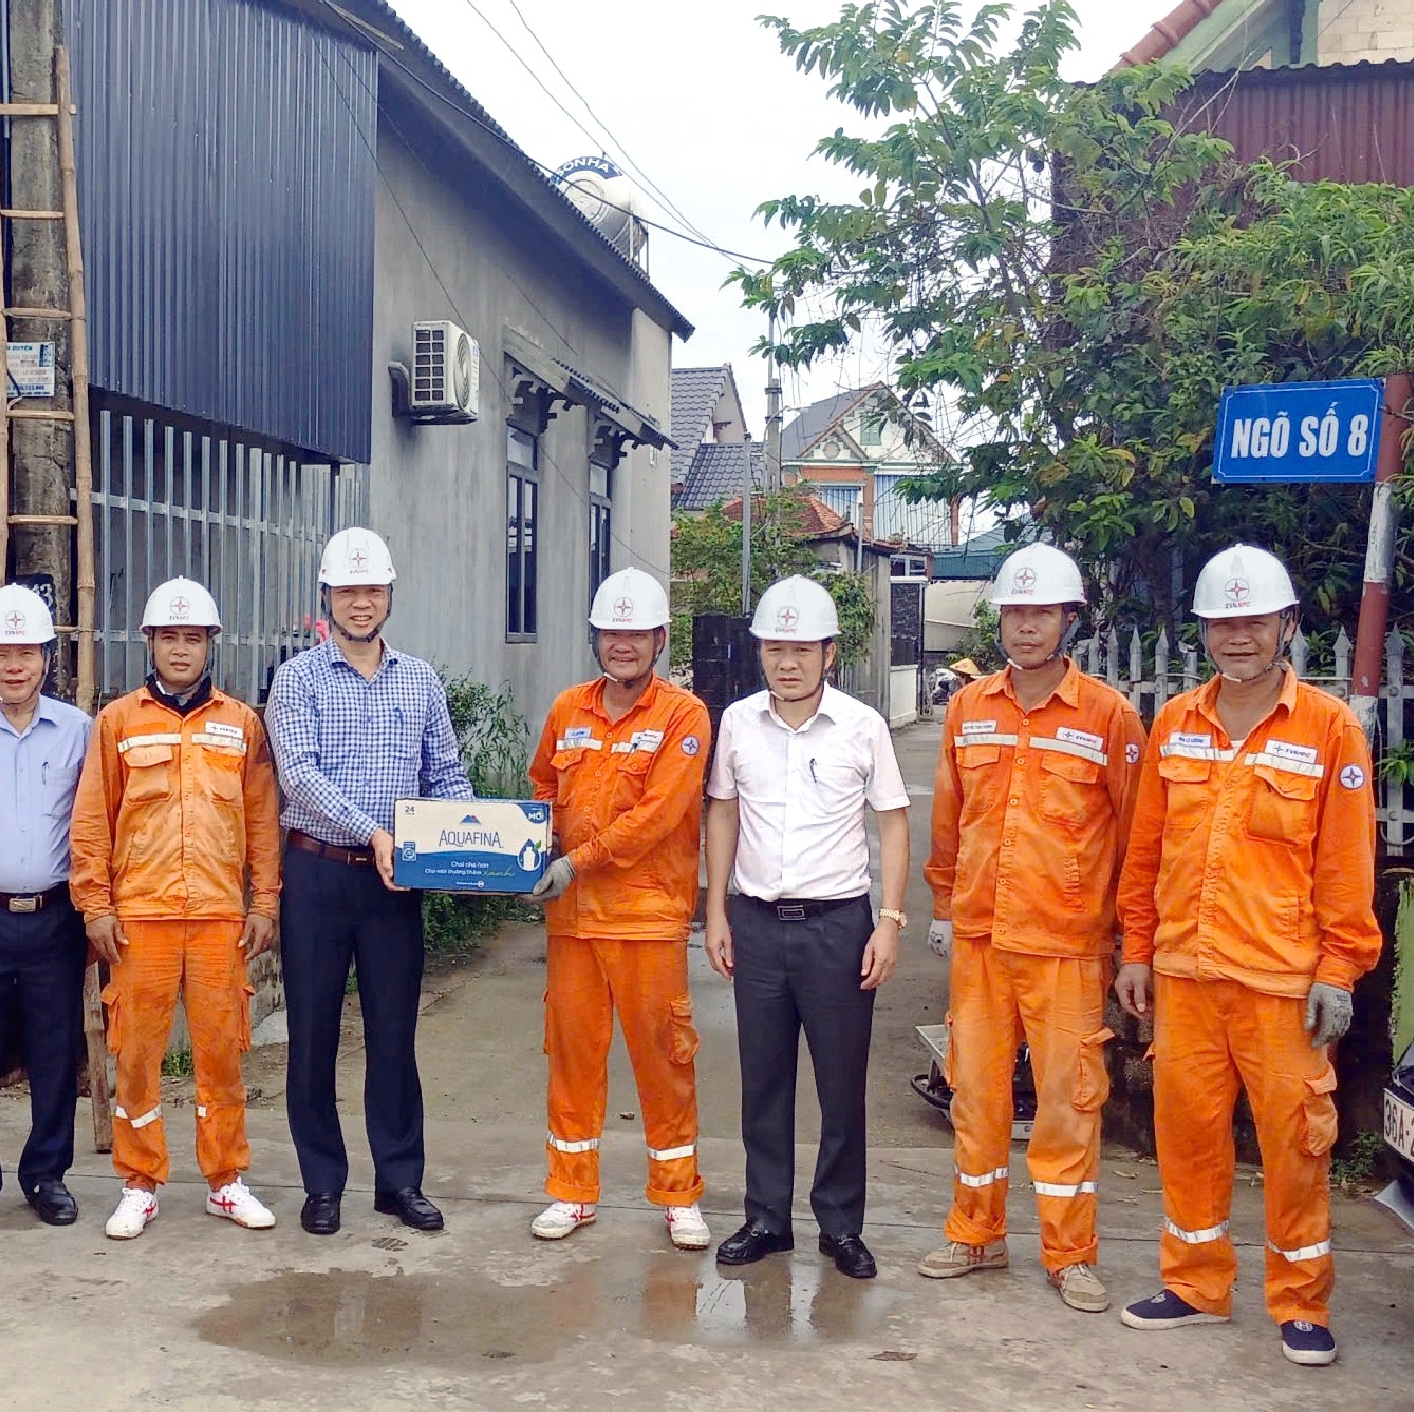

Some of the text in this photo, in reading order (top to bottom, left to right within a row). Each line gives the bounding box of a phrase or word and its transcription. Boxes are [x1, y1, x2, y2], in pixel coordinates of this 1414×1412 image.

[1231, 402, 1369, 459] NGÕ SỐ 8
[438, 829, 504, 849] AQUAFINA
